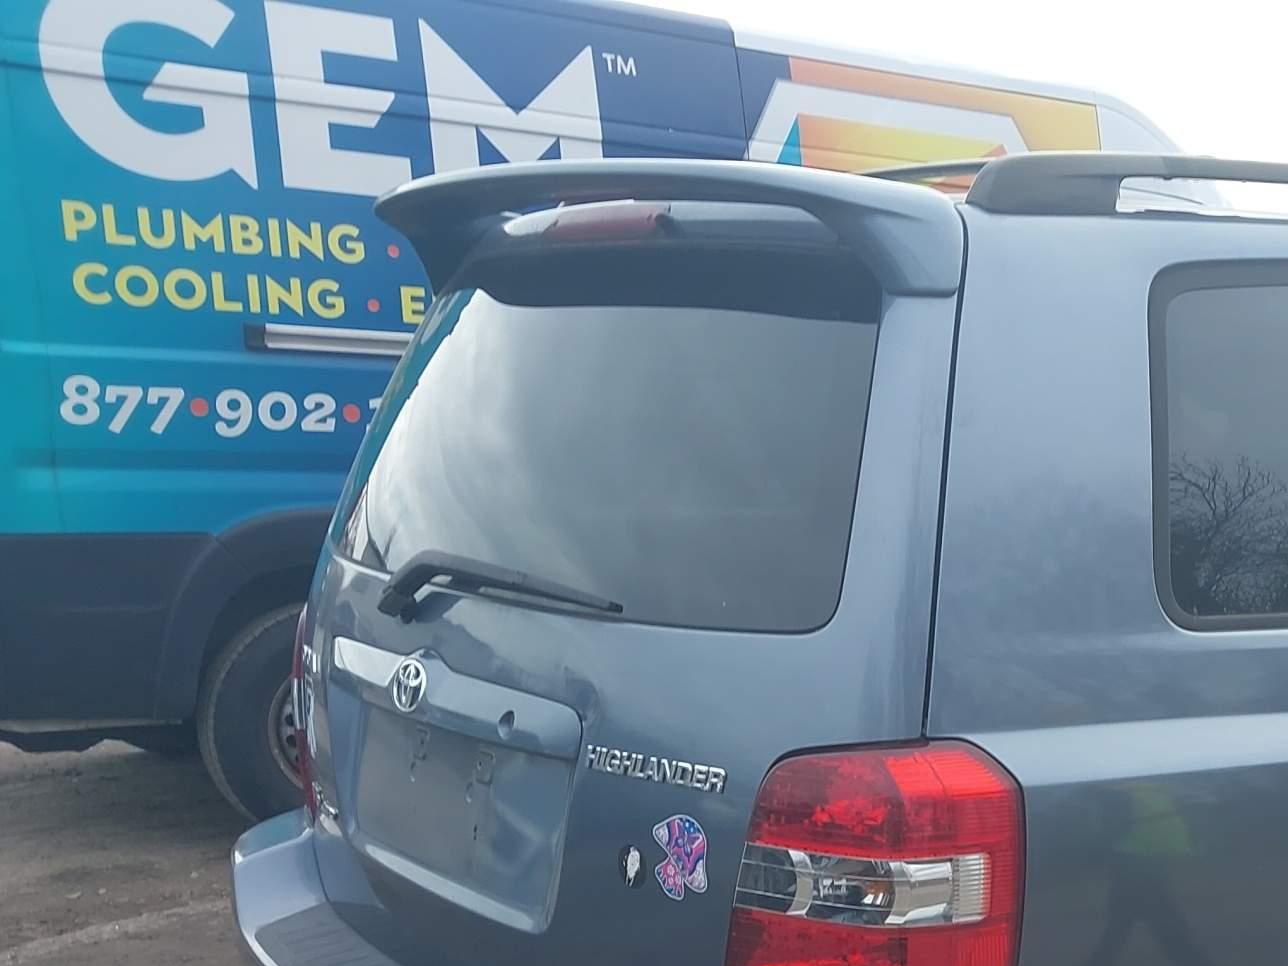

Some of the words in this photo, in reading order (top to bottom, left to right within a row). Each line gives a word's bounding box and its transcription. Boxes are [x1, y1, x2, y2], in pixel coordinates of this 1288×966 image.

[40, 0, 604, 197] GEM
[60, 200, 366, 264] PLUMBING
[73, 263, 346, 318] COOLING
[586, 744, 726, 792] HIGHLANDER
